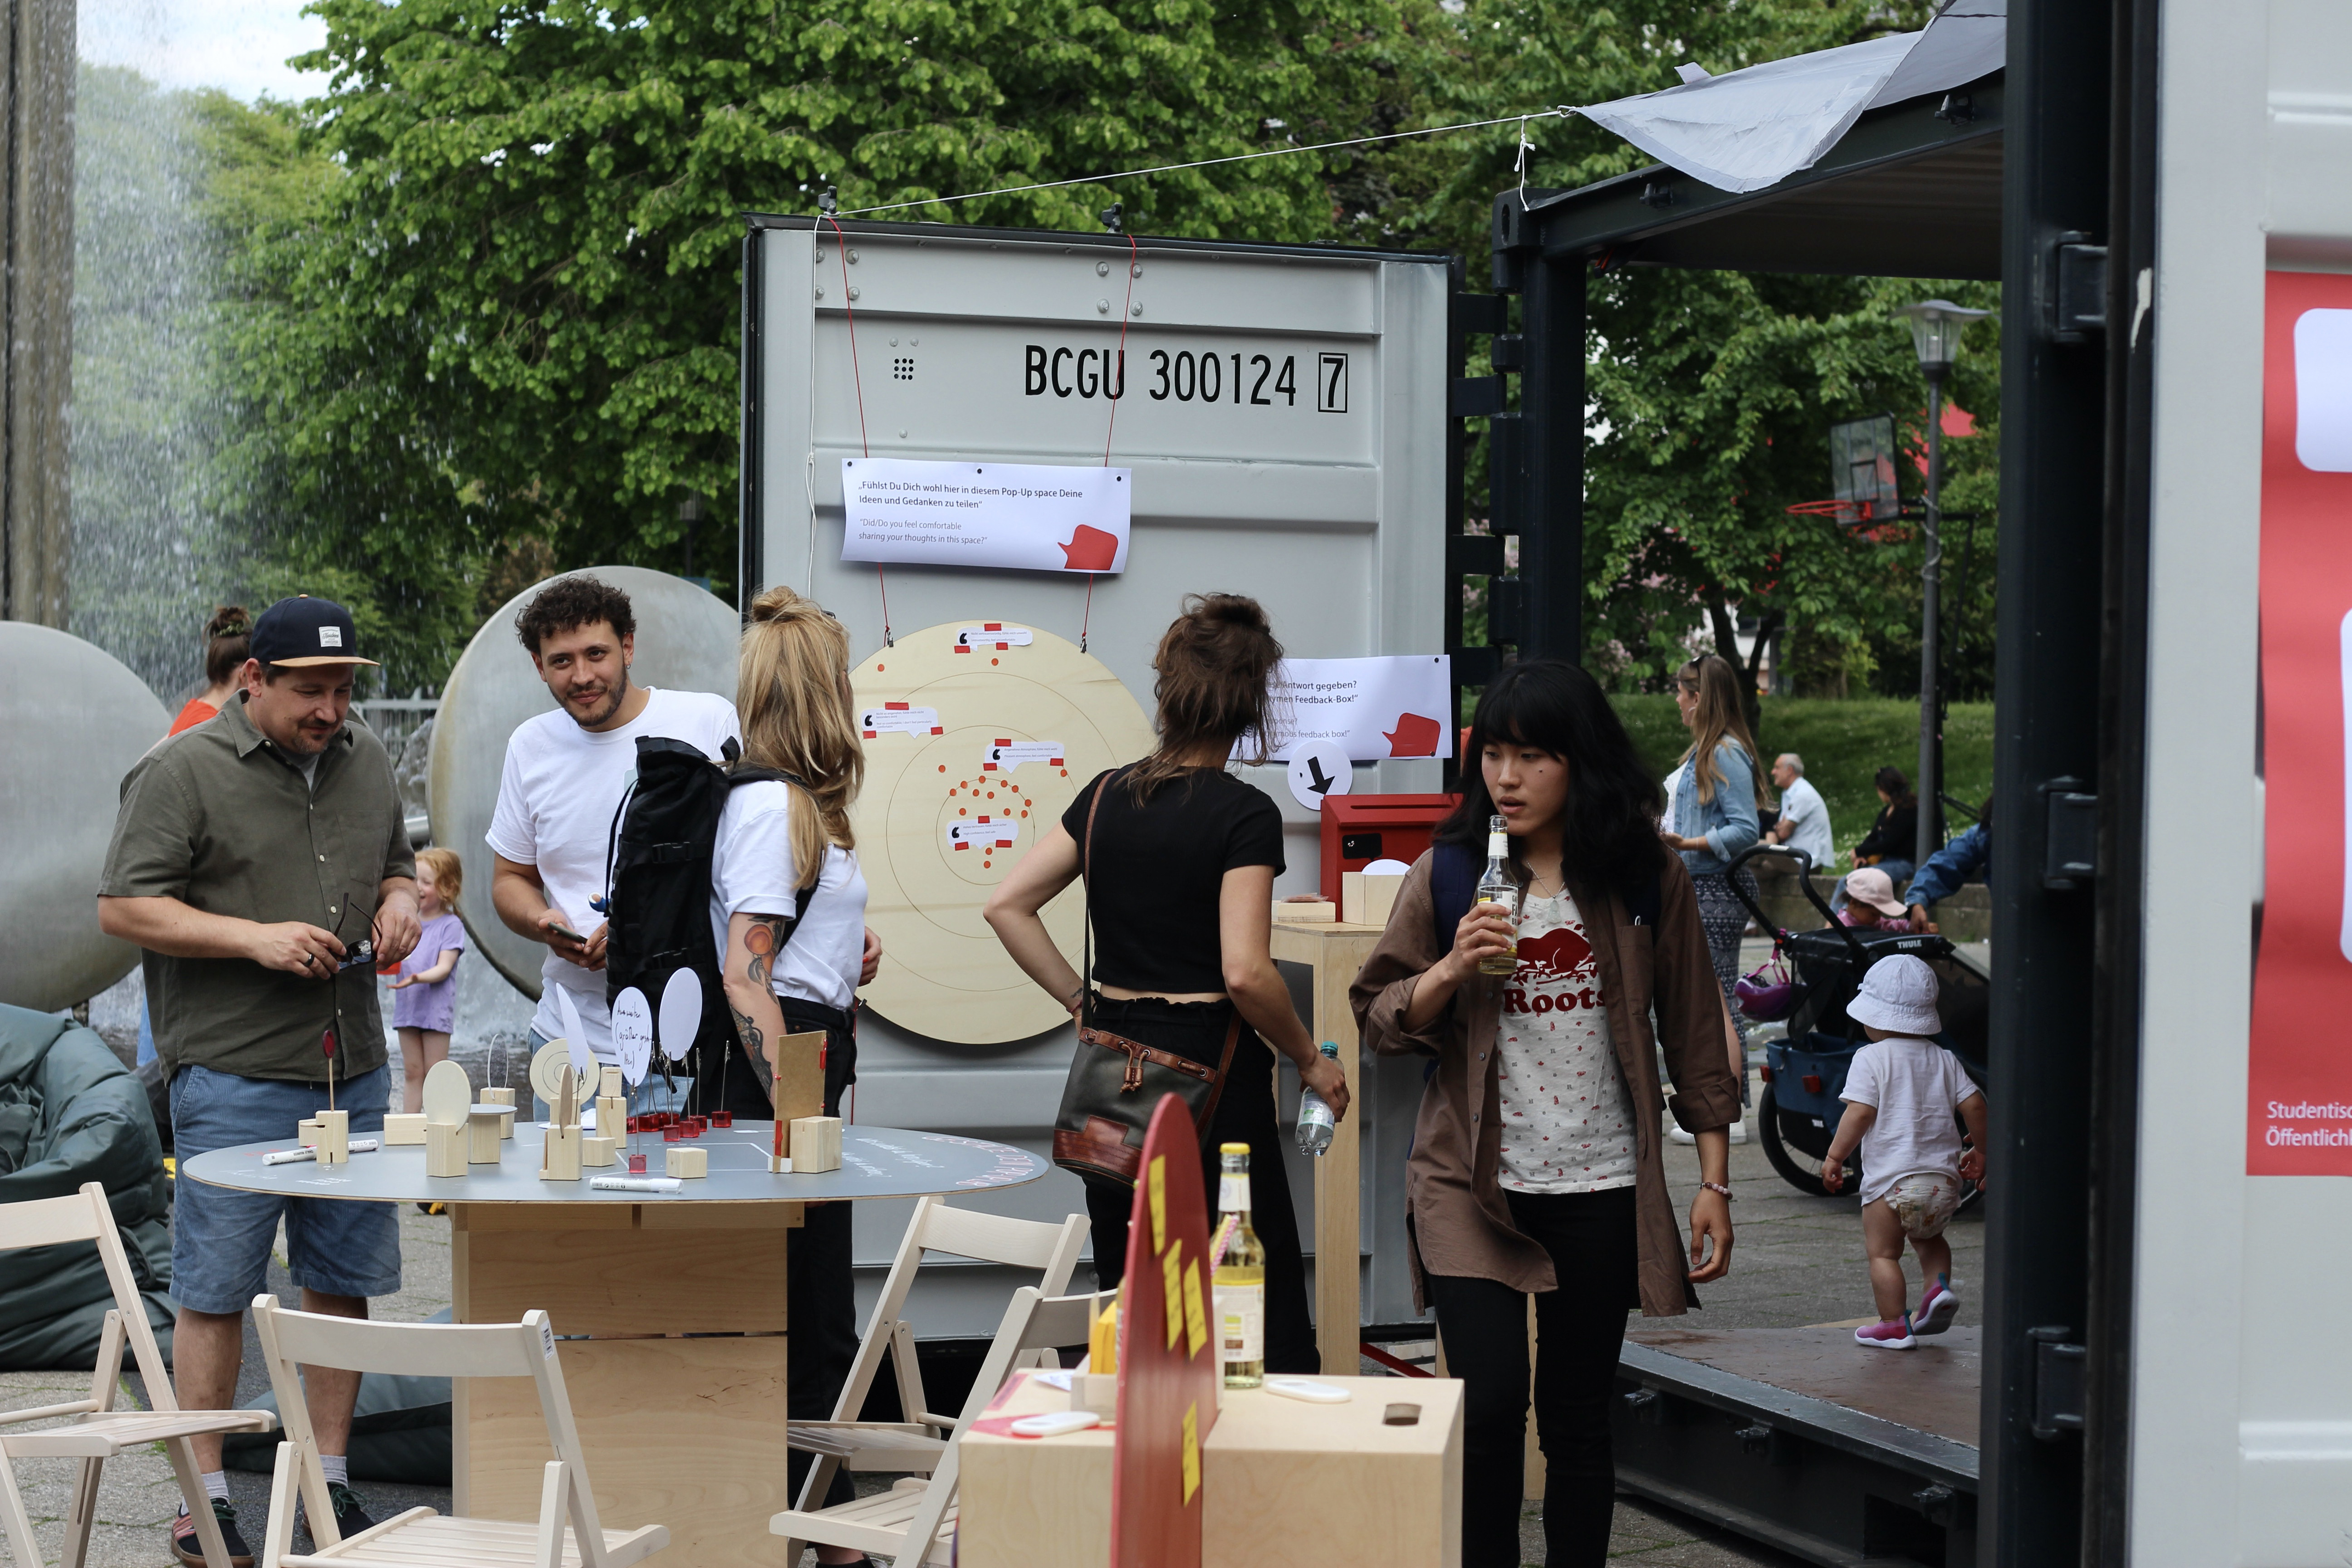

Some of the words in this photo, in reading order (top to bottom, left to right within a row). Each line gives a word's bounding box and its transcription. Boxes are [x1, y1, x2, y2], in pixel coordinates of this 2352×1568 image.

[1025, 345, 1125, 400] BCGU
[1149, 349, 1296, 406] 300124
[1323, 358, 1344, 408] 7
[890, 482, 901, 490] Du
[903, 483, 921, 491] Dich
[923, 484, 942, 492] wohl
[944, 485, 960, 493] hier
[961, 485, 969, 494] in
[971, 486, 1000, 495] diesem
[1002, 487, 1033, 498] Pop-Up
[1034, 490, 1058, 498] space
[1059, 489, 1083, 498] Deine
[859, 495, 882, 504] Ideen
[885, 496, 901, 505] und
[902, 497, 943, 506] Gedanken
[905, 520, 917, 528] feel
[919, 521, 962, 530] comfortable
[858, 532, 885, 541] sharing
[887, 534, 903, 542] your
[904, 534, 936, 543] thoughts
[946, 535, 959, 543] this
[1283, 681, 1314, 690] Antwort
[1316, 680, 1357, 692] gegeben?
[1298, 730, 1330, 738] feedback
[1897, 939, 1922, 949] THULE
[1503, 987, 1606, 1014] Roots
